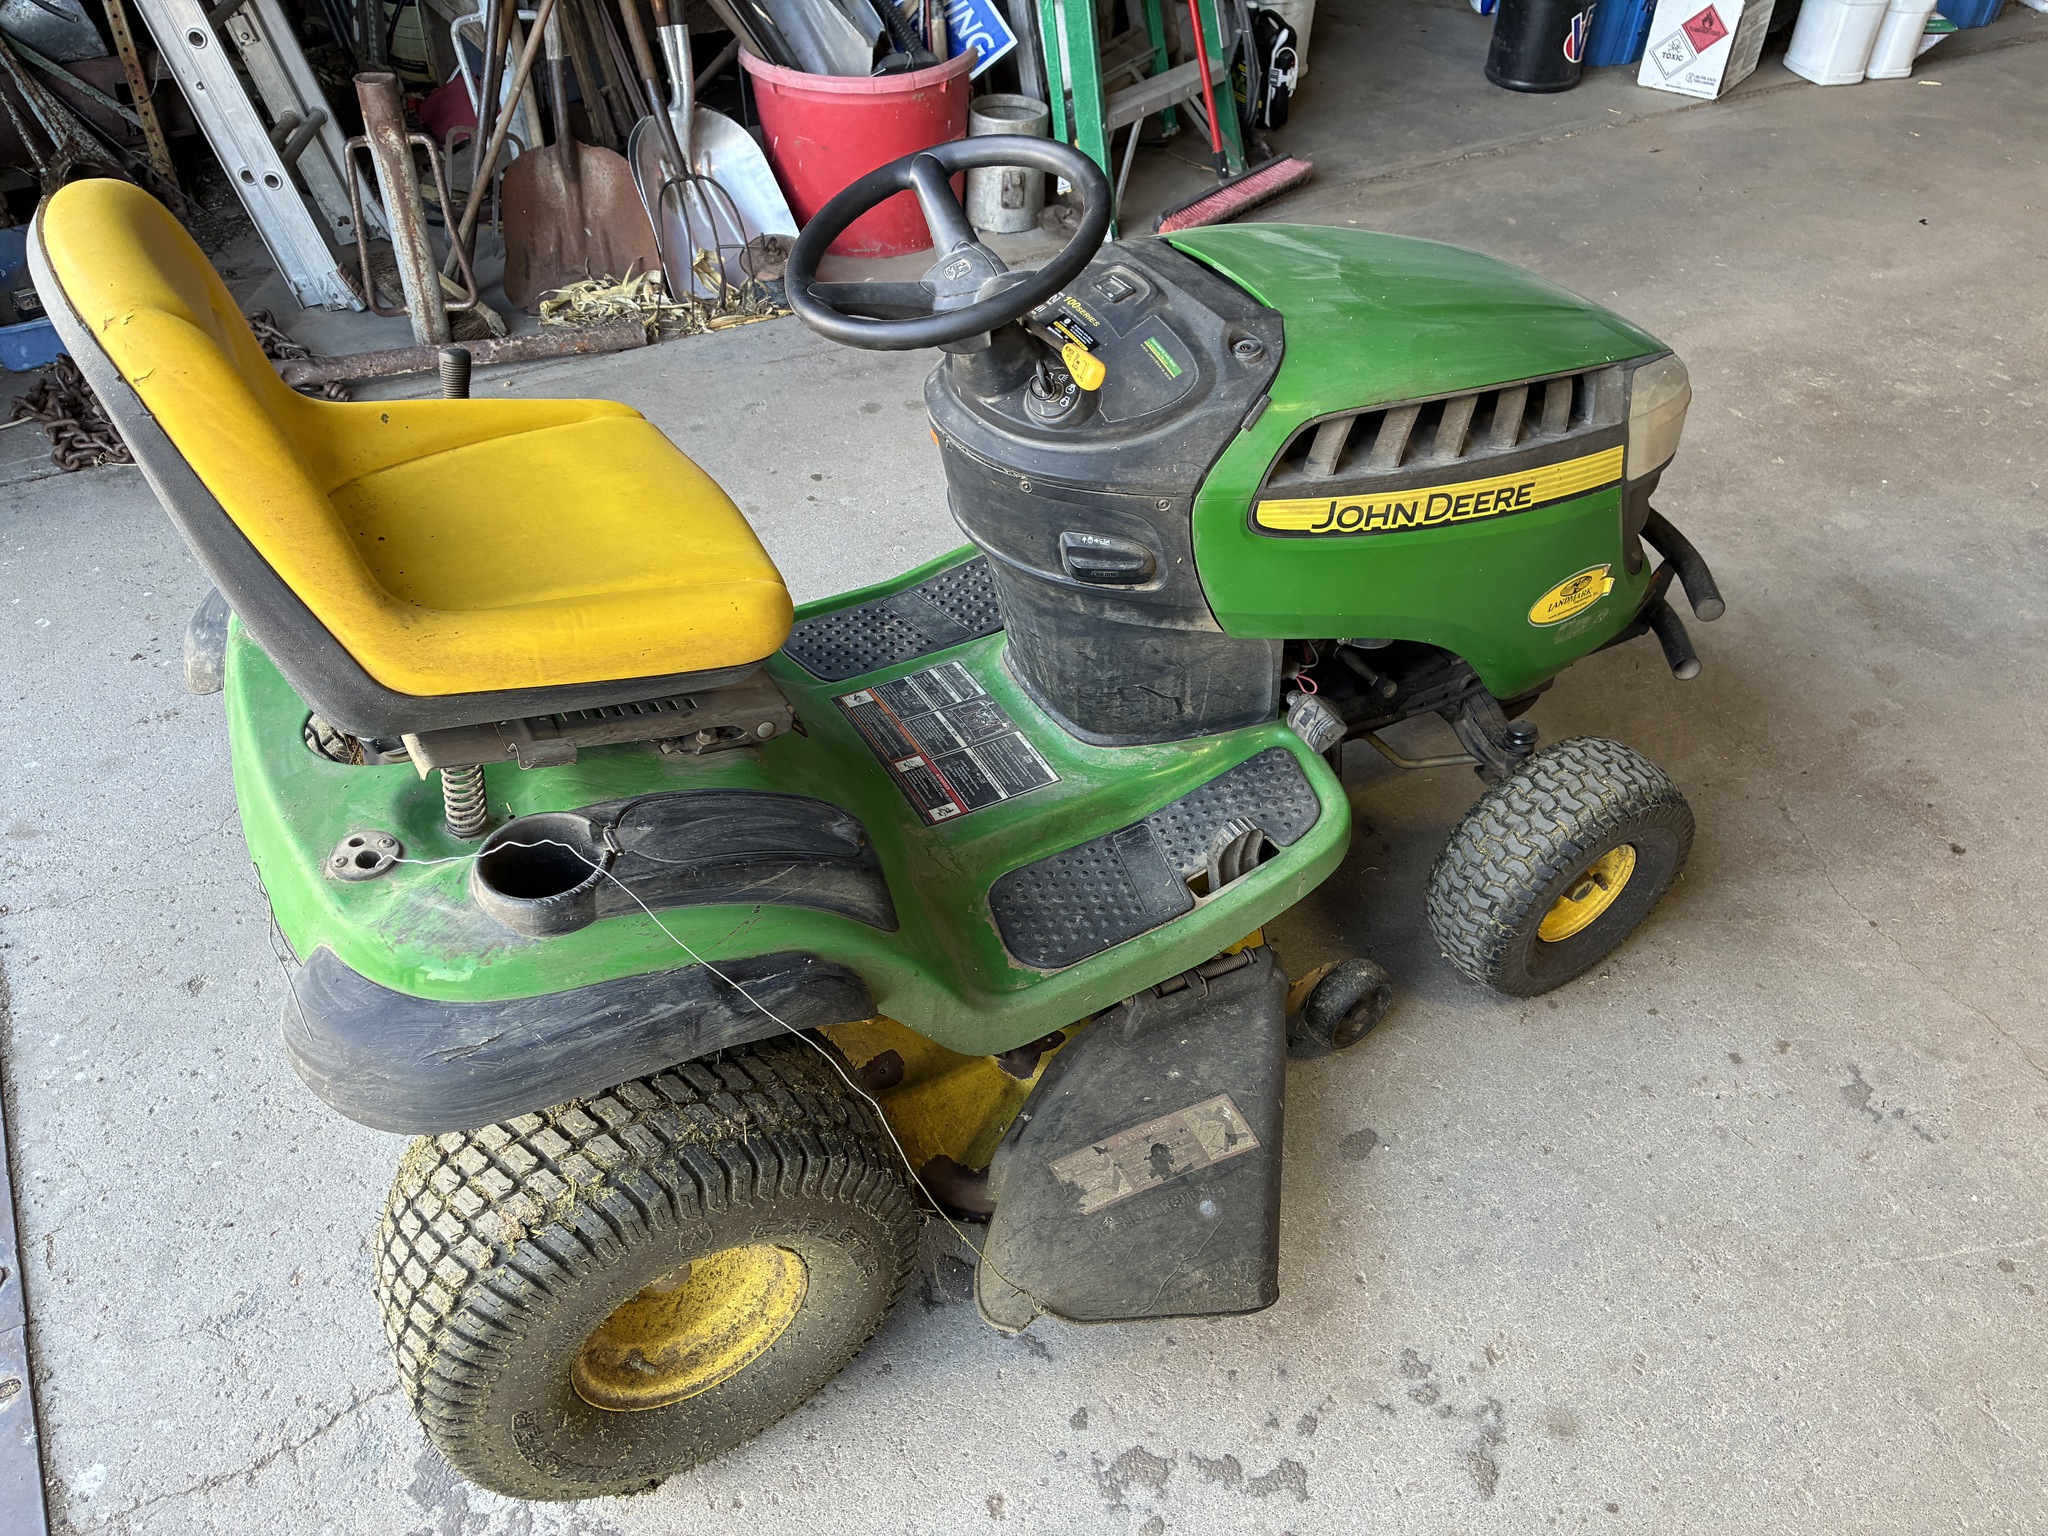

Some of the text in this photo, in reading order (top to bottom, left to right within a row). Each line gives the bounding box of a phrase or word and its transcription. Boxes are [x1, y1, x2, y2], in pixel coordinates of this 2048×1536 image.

[1661, 51, 1684, 62] TOXIC
[1311, 482, 1536, 531] JOHN DEERE
[1547, 589, 1592, 612] LANDMARK
[1127, 1119, 1173, 1142] DANGER
